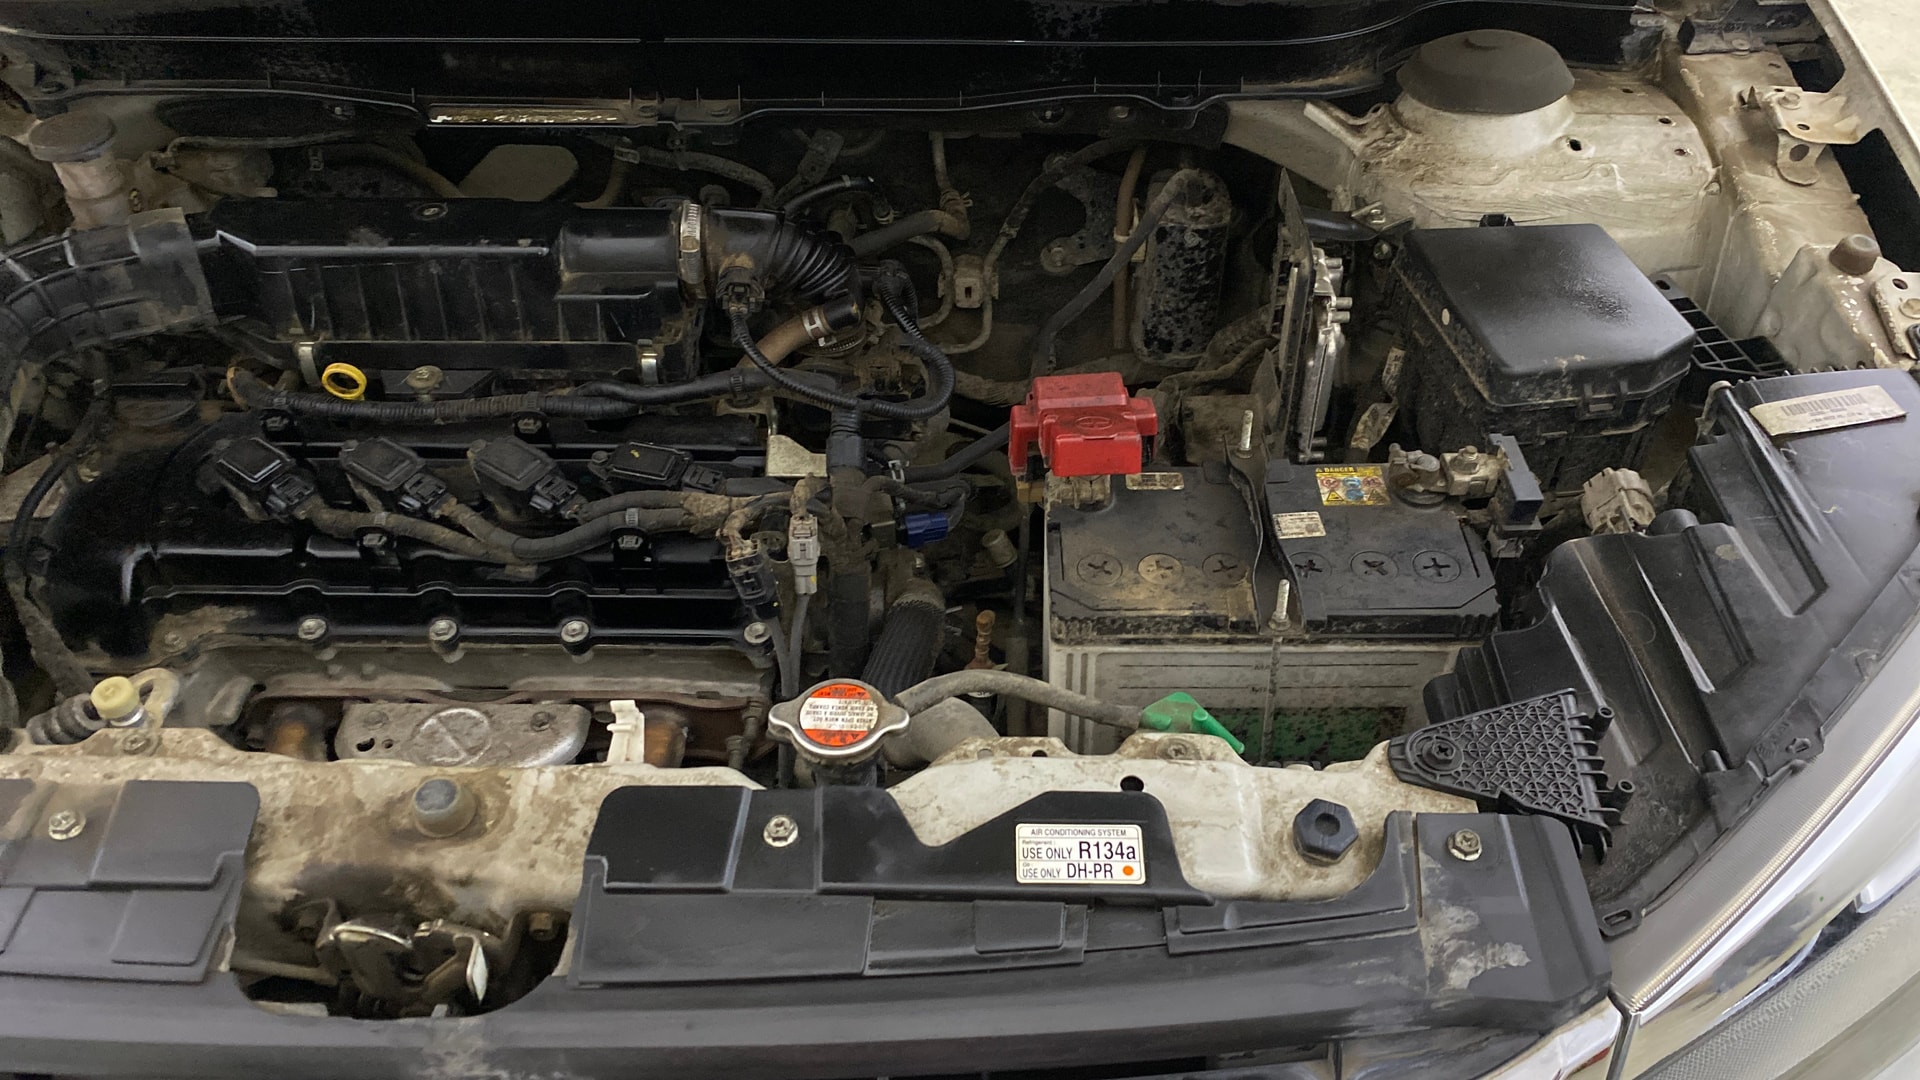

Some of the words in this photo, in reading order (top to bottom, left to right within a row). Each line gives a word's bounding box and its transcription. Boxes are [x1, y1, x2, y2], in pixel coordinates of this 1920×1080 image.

[1031, 828, 1043, 836] AIR
[1044, 828, 1096, 836] CONDITIONING
[1022, 847, 1042, 859] USE
[1045, 847, 1073, 859] ONLY
[1079, 841, 1136, 860] R134a
[1022, 868, 1038, 878] USE
[1040, 868, 1061, 878] ONLY
[1067, 863, 1113, 879] DH-PR
